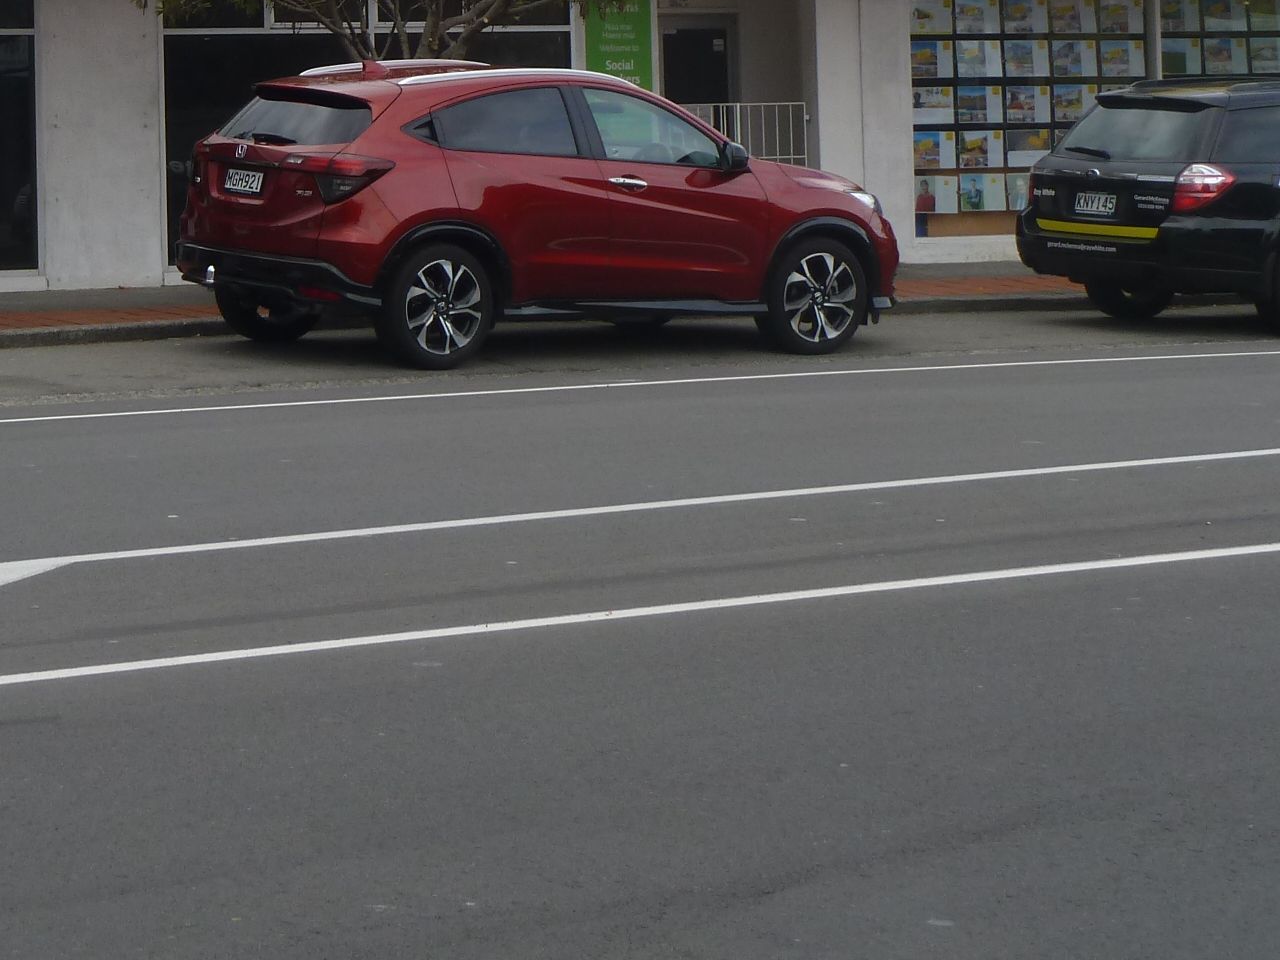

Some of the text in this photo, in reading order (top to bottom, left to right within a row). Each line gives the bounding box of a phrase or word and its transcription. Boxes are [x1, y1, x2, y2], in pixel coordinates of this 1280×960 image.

[605, 59, 634, 70] Social
[225, 171, 261, 190] MGH921
[1077, 193, 1115, 210] KNY145
